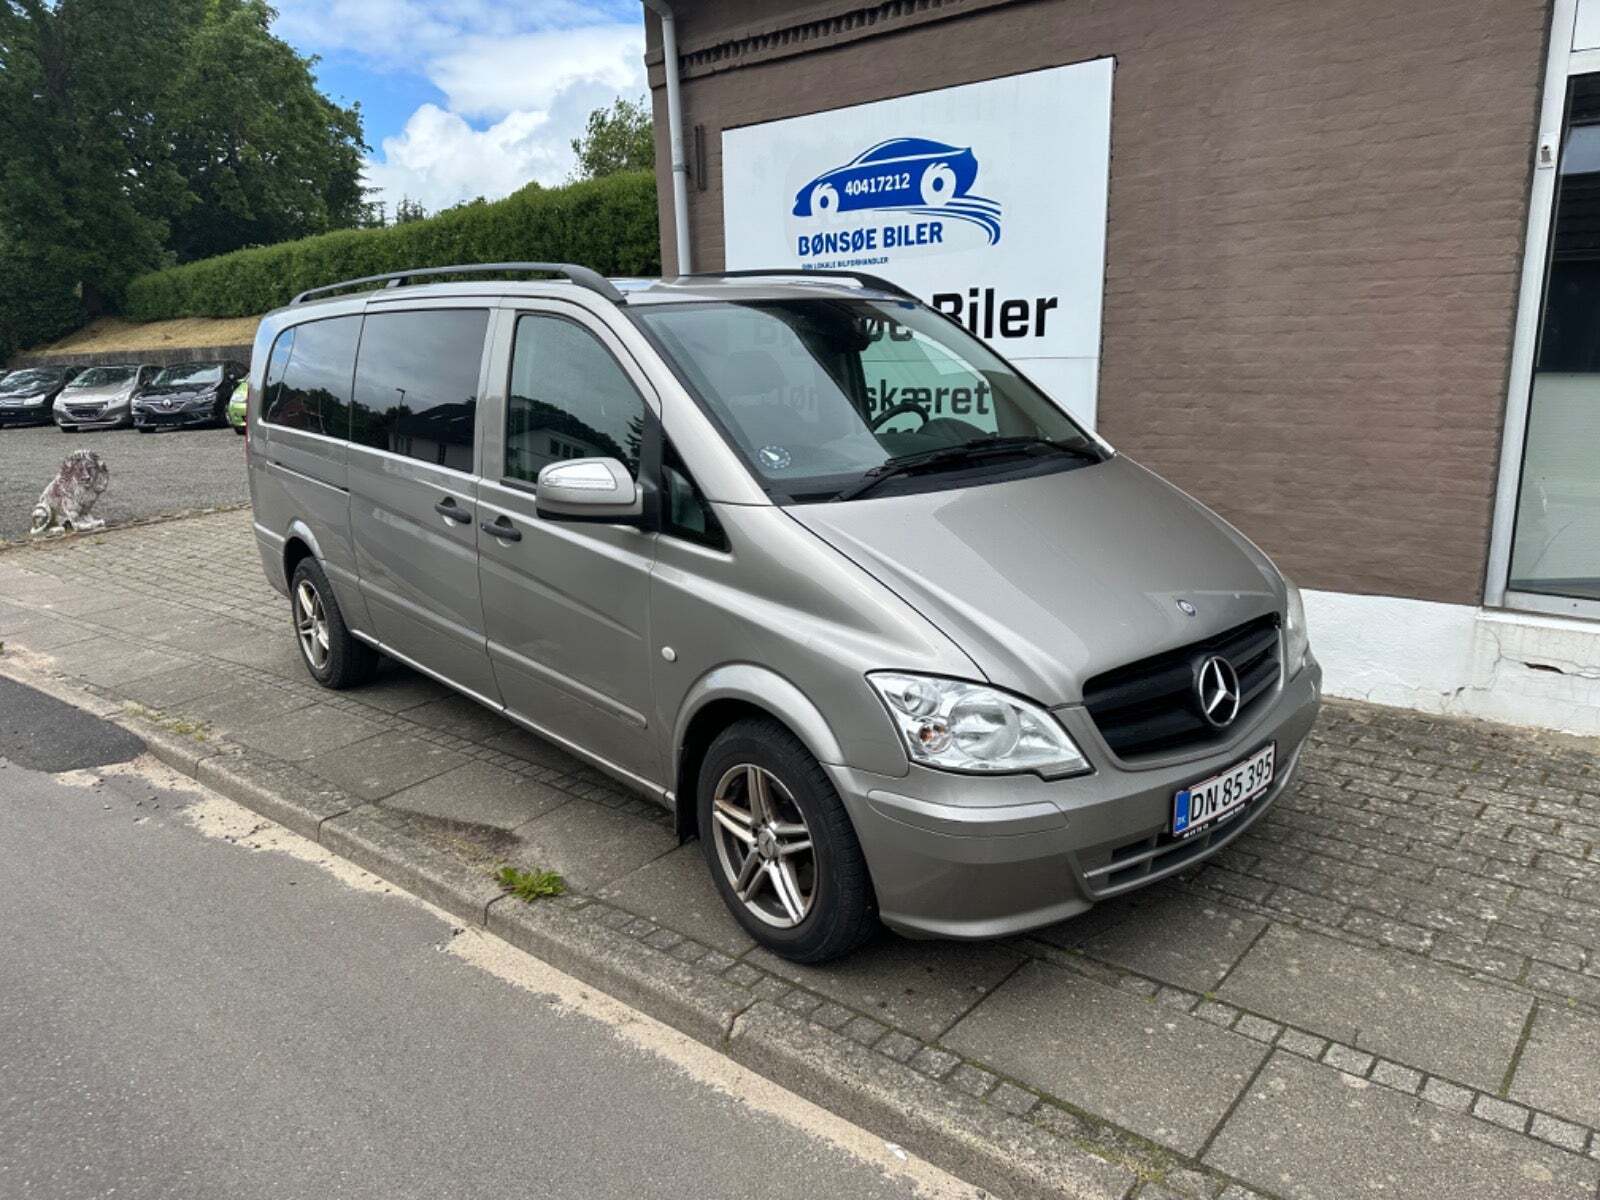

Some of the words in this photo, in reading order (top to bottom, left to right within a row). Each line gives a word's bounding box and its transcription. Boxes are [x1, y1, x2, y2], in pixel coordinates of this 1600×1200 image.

[844, 172, 910, 196] 40417212
[798, 227, 877, 256] BØNSØE
[883, 221, 943, 248] BILER
[1191, 785, 1218, 821] DN
[1222, 771, 1243, 806] 85
[1246, 751, 1272, 792] 395
